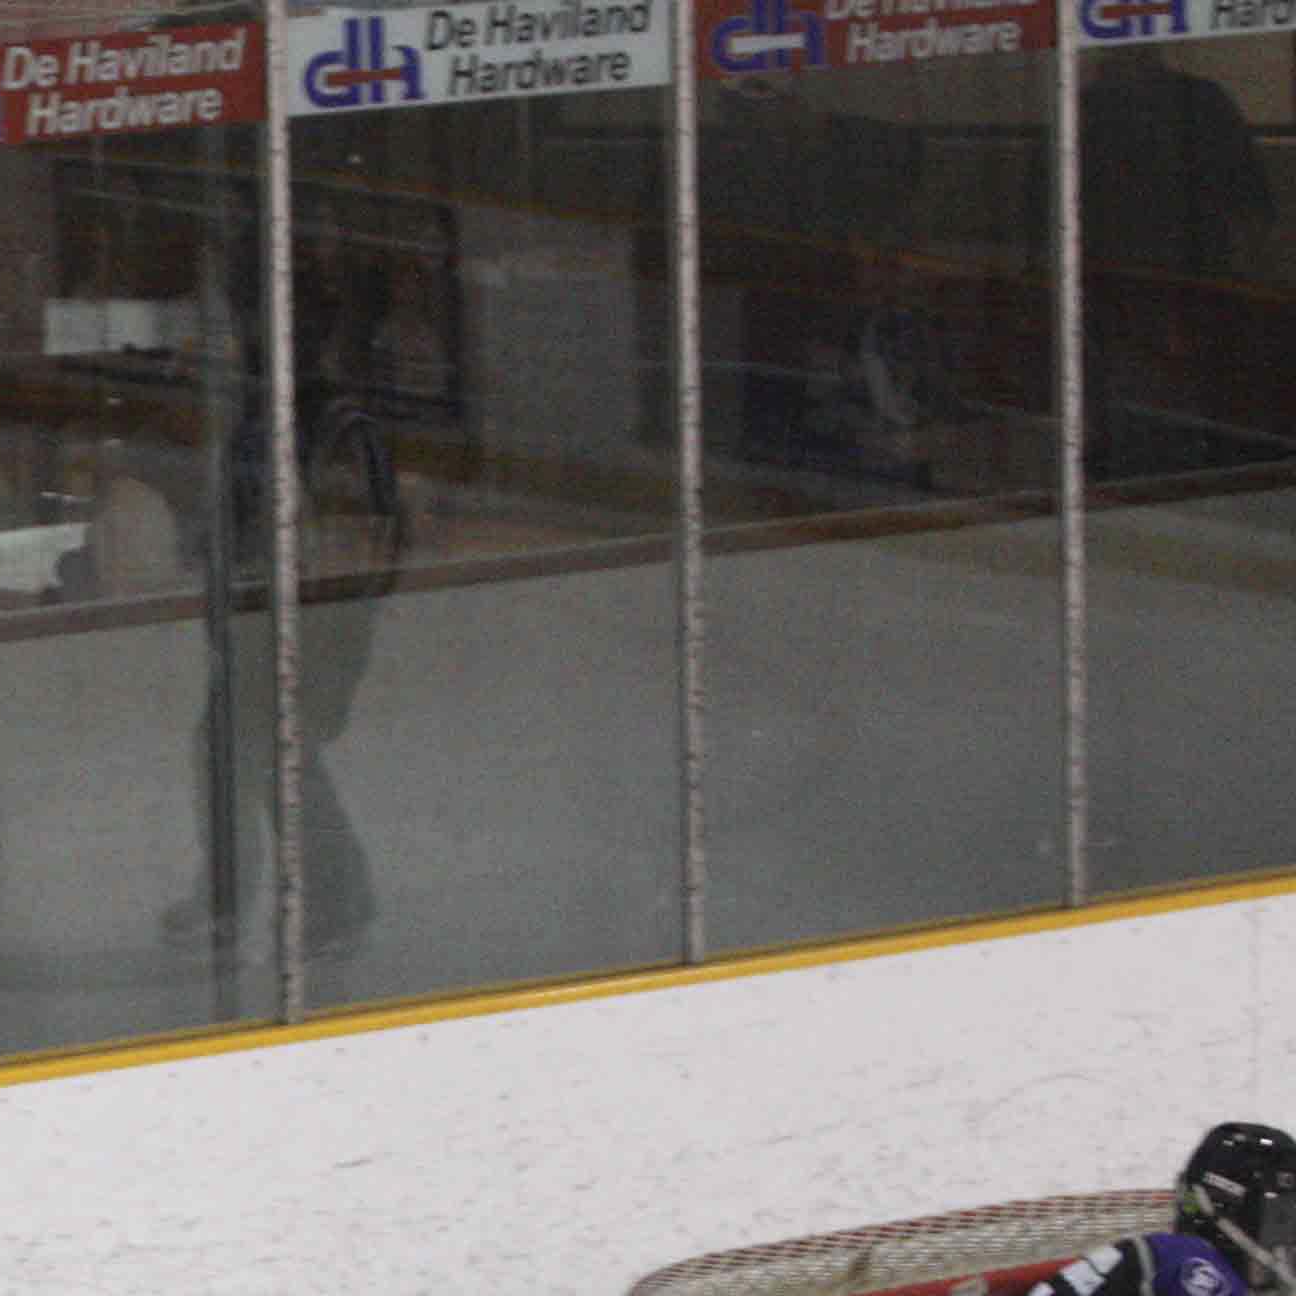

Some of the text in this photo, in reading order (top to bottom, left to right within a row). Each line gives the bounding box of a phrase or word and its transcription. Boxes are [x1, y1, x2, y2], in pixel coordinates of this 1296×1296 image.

[426, 0, 653, 51] De Haviland
[847, 17, 1021, 63] Hardware
[1, 28, 247, 89] De Haviland
[448, 49, 631, 96] Hardware
[26, 86, 223, 136] Hardware
